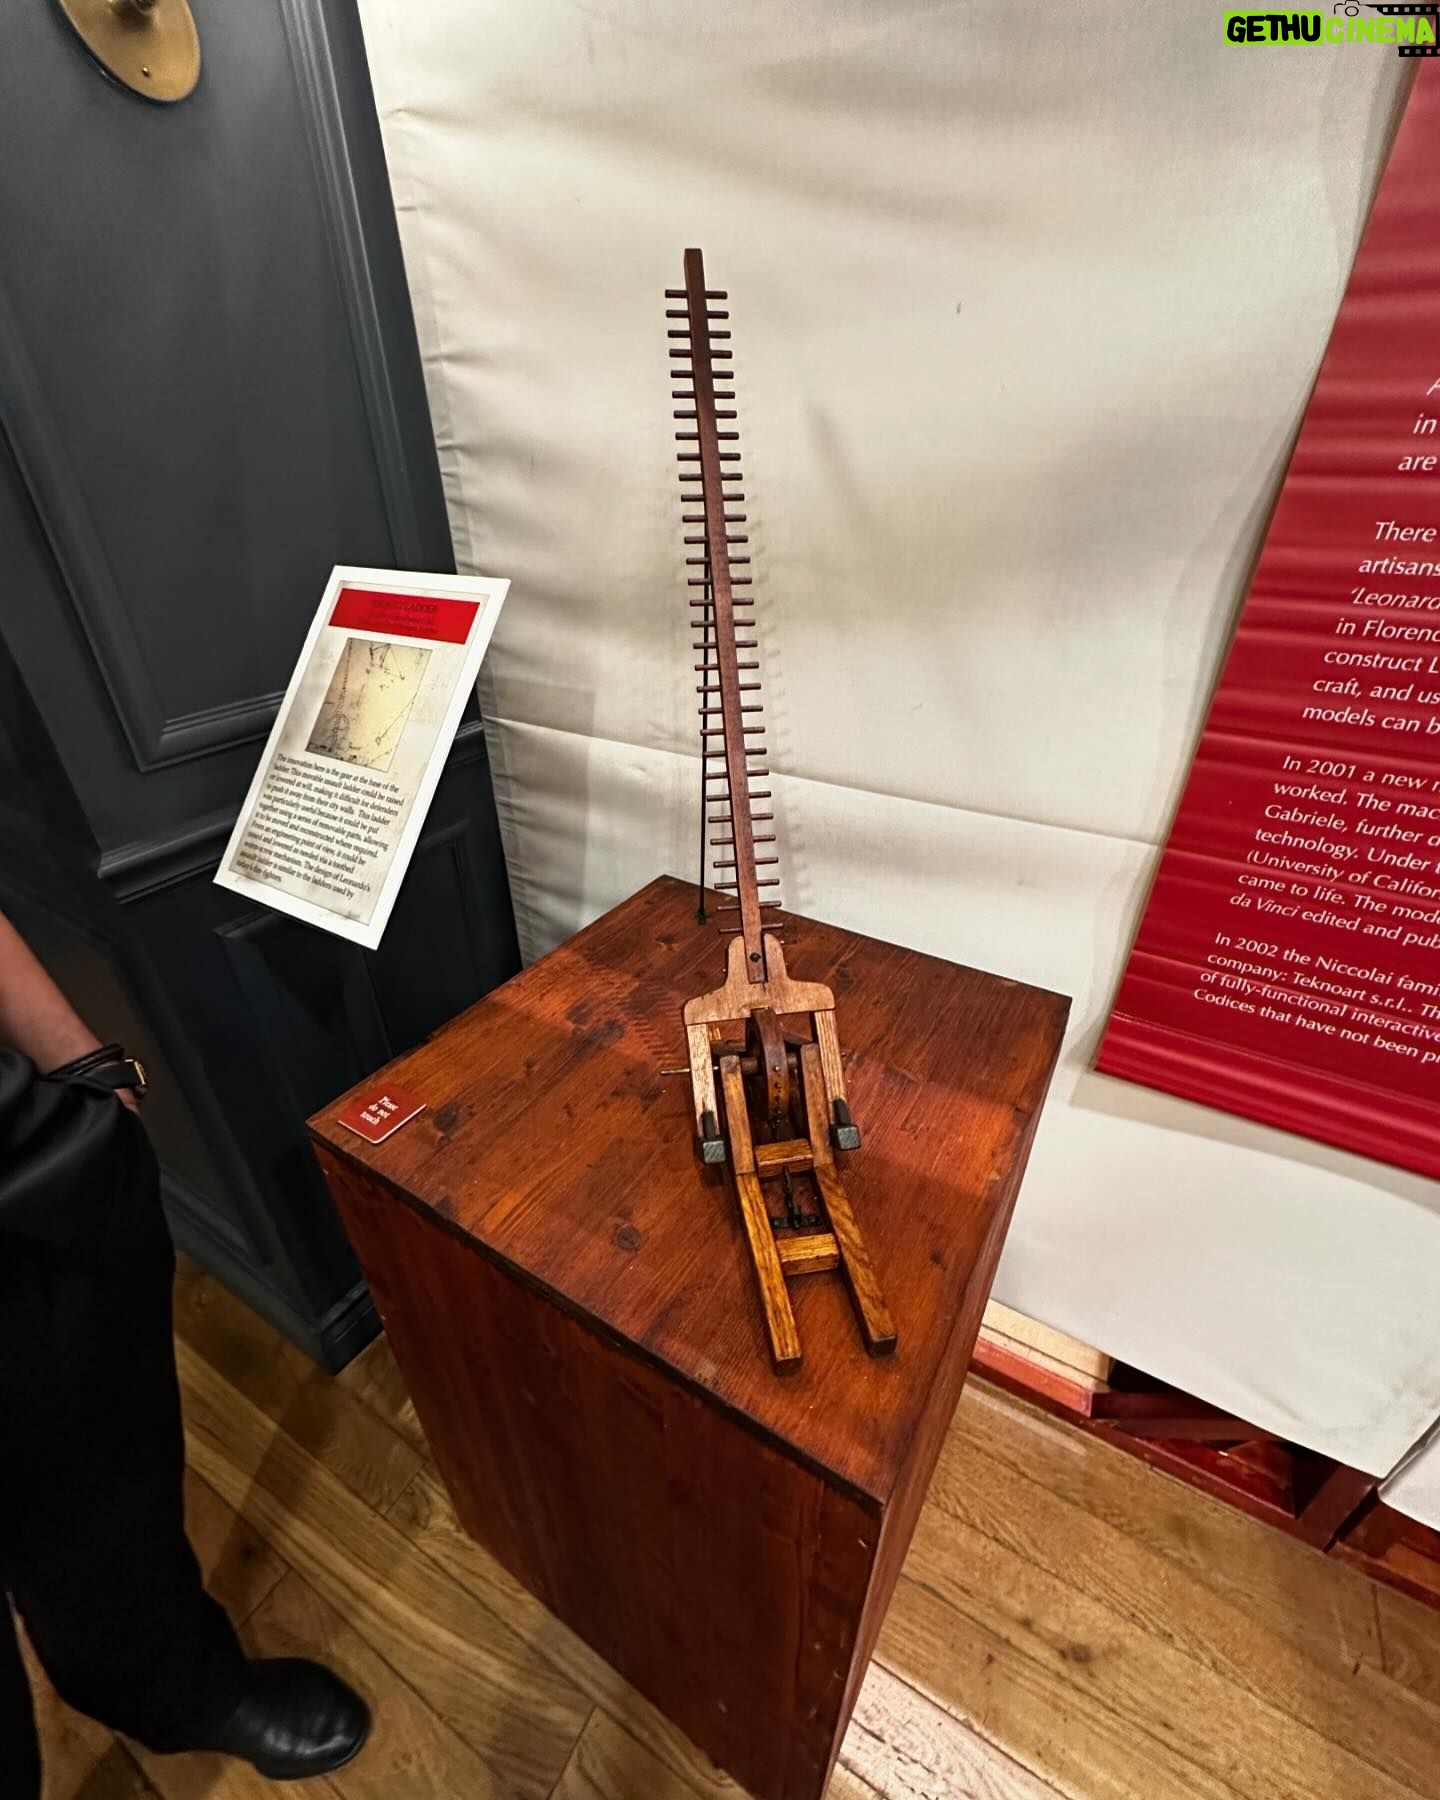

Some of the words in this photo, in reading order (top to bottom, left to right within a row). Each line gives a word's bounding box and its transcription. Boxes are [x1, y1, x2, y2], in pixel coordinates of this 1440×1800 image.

[1412, 412, 1438, 435] in
[1398, 455, 1438, 471] are
[1375, 520, 1437, 542] There
[1358, 556, 1440, 577] artisans
[1335, 618, 1356, 635] in
[1324, 651, 1423, 672] construct
[1428, 656, 1440, 674] L
[1313, 678, 1362, 698] craft,
[1370, 683, 1414, 701] and
[1417, 690, 1440, 705] us
[1302, 706, 1376, 726] models
[1381, 716, 1421, 732] can
[1282, 755, 1301, 771] In
[1306, 759, 1356, 779] 2001
[1362, 770, 1375, 782] a
[1381, 773, 1428, 789] new
[1274, 783, 1347, 805] worked.
[1357, 792, 1391, 812] The
[1395, 803, 1440, 820] mac
[1264, 804, 1348, 832] Gabriele,
[1355, 819, 1424, 843] further
[1255, 828, 1358, 861] technology.
[1367, 847, 1431, 871] Under
[1246, 849, 1345, 882] (University
[1348, 871, 1371, 884] of
[1238, 874, 1286, 892] came
[1290, 883, 1308, 897] to
[1313, 885, 1346, 905] life.
[1353, 894, 1387, 913] The
[1230, 892, 1251, 908] da
[1256, 897, 1301, 918] Vinci
[1301, 910, 1361, 932] edited
[1362, 924, 1402, 940] and
[1207, 954, 1289, 982] company:
[1293, 971, 1367, 1001] Teknoart
[1215, 932, 1231, 947] In
[1234, 937, 1279, 958] 2002
[1283, 948, 1312, 965] the
[1315, 956, 1395, 986] Niccolai
[1397, 974, 1440, 997] fami
[1200, 972, 1221, 984] of
[1220, 974, 1349, 1017] fully-functional
[1193, 988, 1257, 1014] Codices
[1260, 1006, 1292, 1023] that
[1295, 1014, 1337, 1036] have
[1340, 1028, 1371, 1045] not
[1373, 1035, 1419, 1057] been
[360, 1111, 381, 1126] touch
[368, 1103, 379, 1112] do
[377, 1109, 391, 1119] not
[378, 1096, 399, 1111] Please
